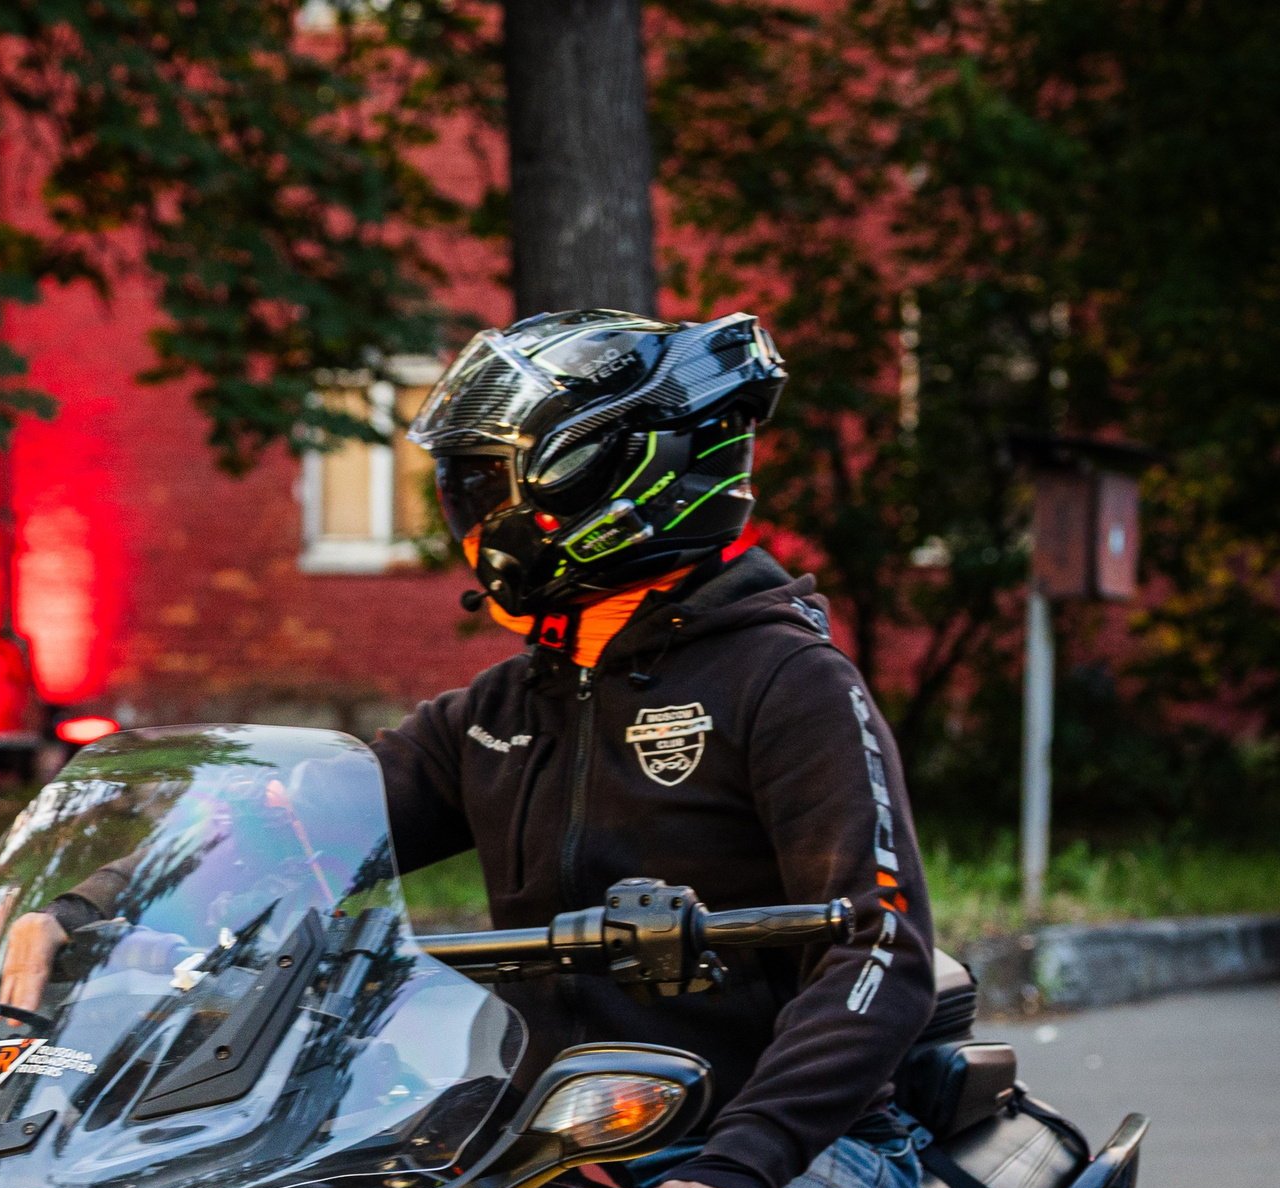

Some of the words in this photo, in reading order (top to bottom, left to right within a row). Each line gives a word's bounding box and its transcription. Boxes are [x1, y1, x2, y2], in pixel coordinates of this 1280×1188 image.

[580, 348, 620, 376] EXO
[588, 353, 637, 383] TECH
[15, 1064, 64, 1077] RIDERS
